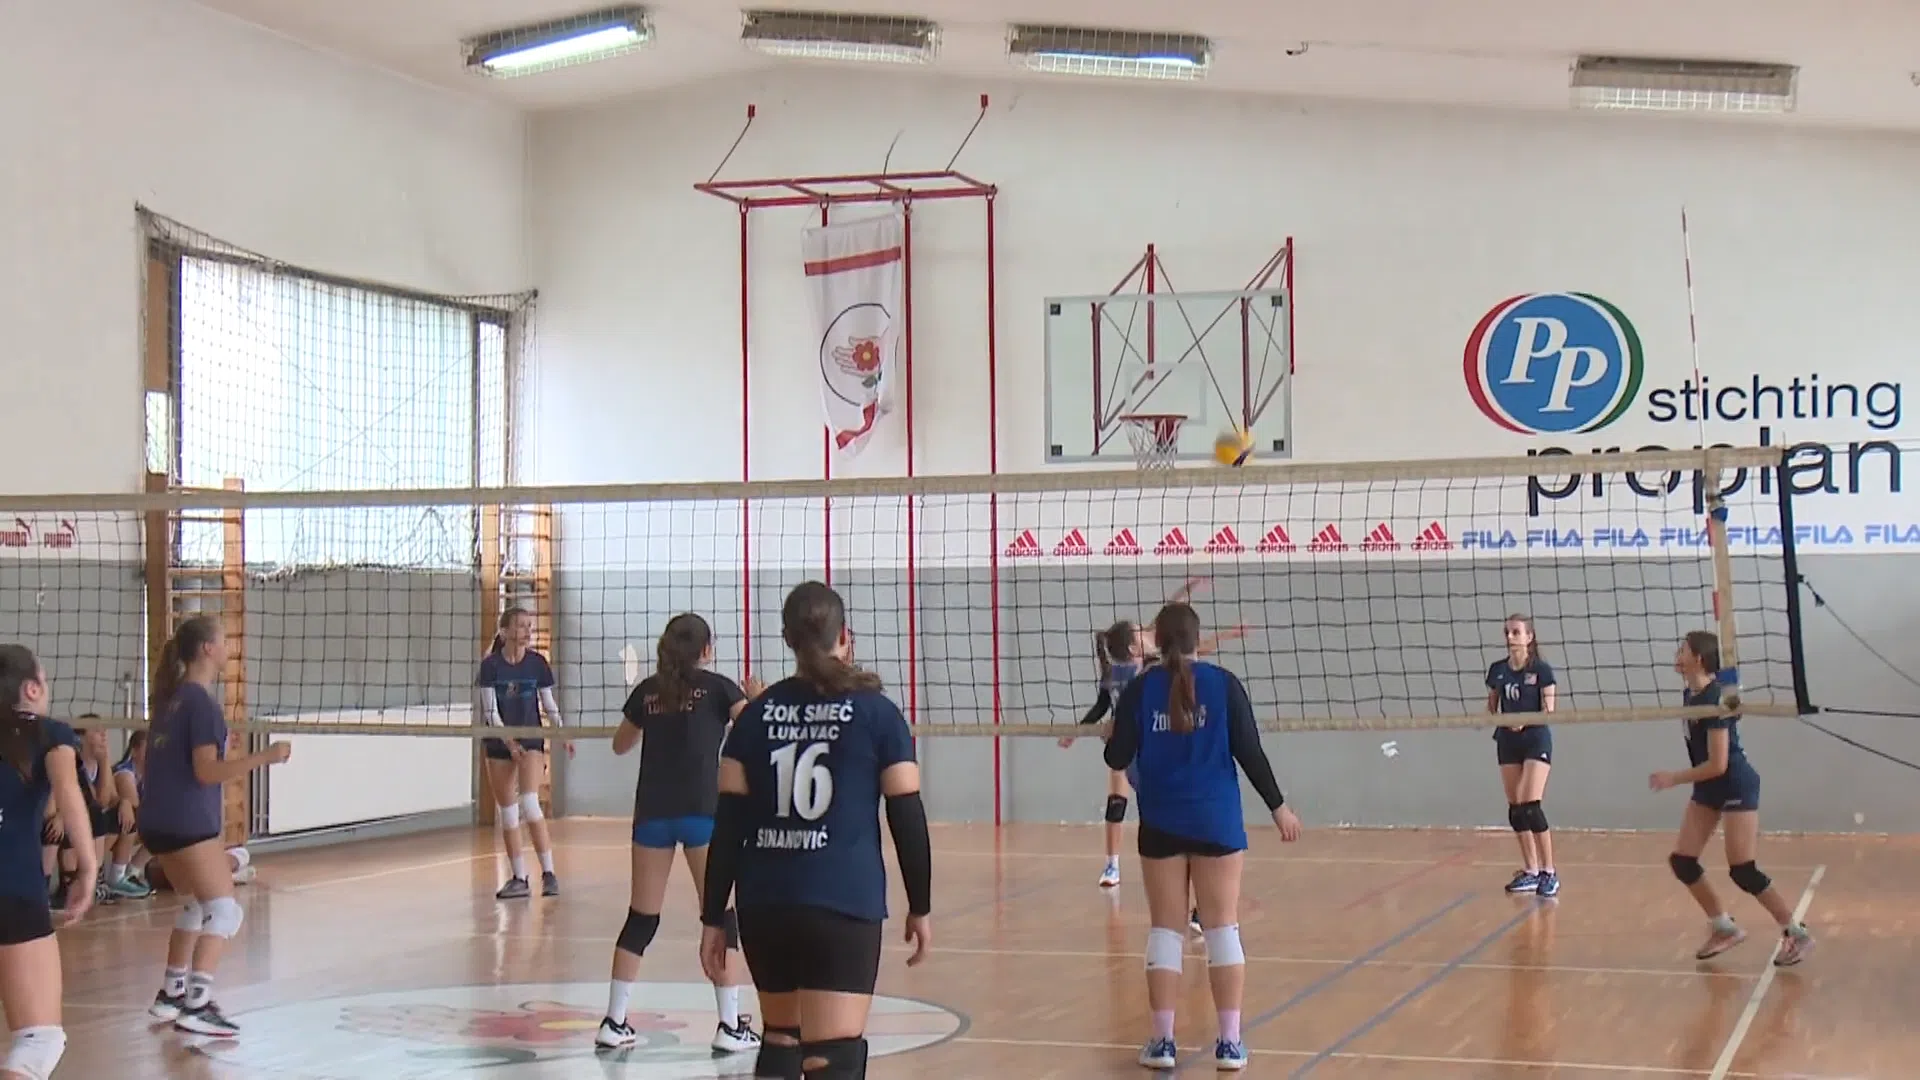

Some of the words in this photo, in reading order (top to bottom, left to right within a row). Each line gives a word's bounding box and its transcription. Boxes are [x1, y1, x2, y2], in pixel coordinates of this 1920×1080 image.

[1647, 373, 1901, 429] stichting
[44, 533, 72, 549] PUMA
[1462, 529, 1517, 550] FILA
[1527, 528, 1583, 548] FILA
[1593, 527, 1650, 548] FILA
[1795, 525, 1854, 545] FILA
[1504, 682, 1520, 701] 16
[762, 698, 800, 724] ŽOK
[803, 698, 854, 723] SMEČ
[767, 724, 840, 741] LUKAVAC
[769, 741, 834, 821] 16
